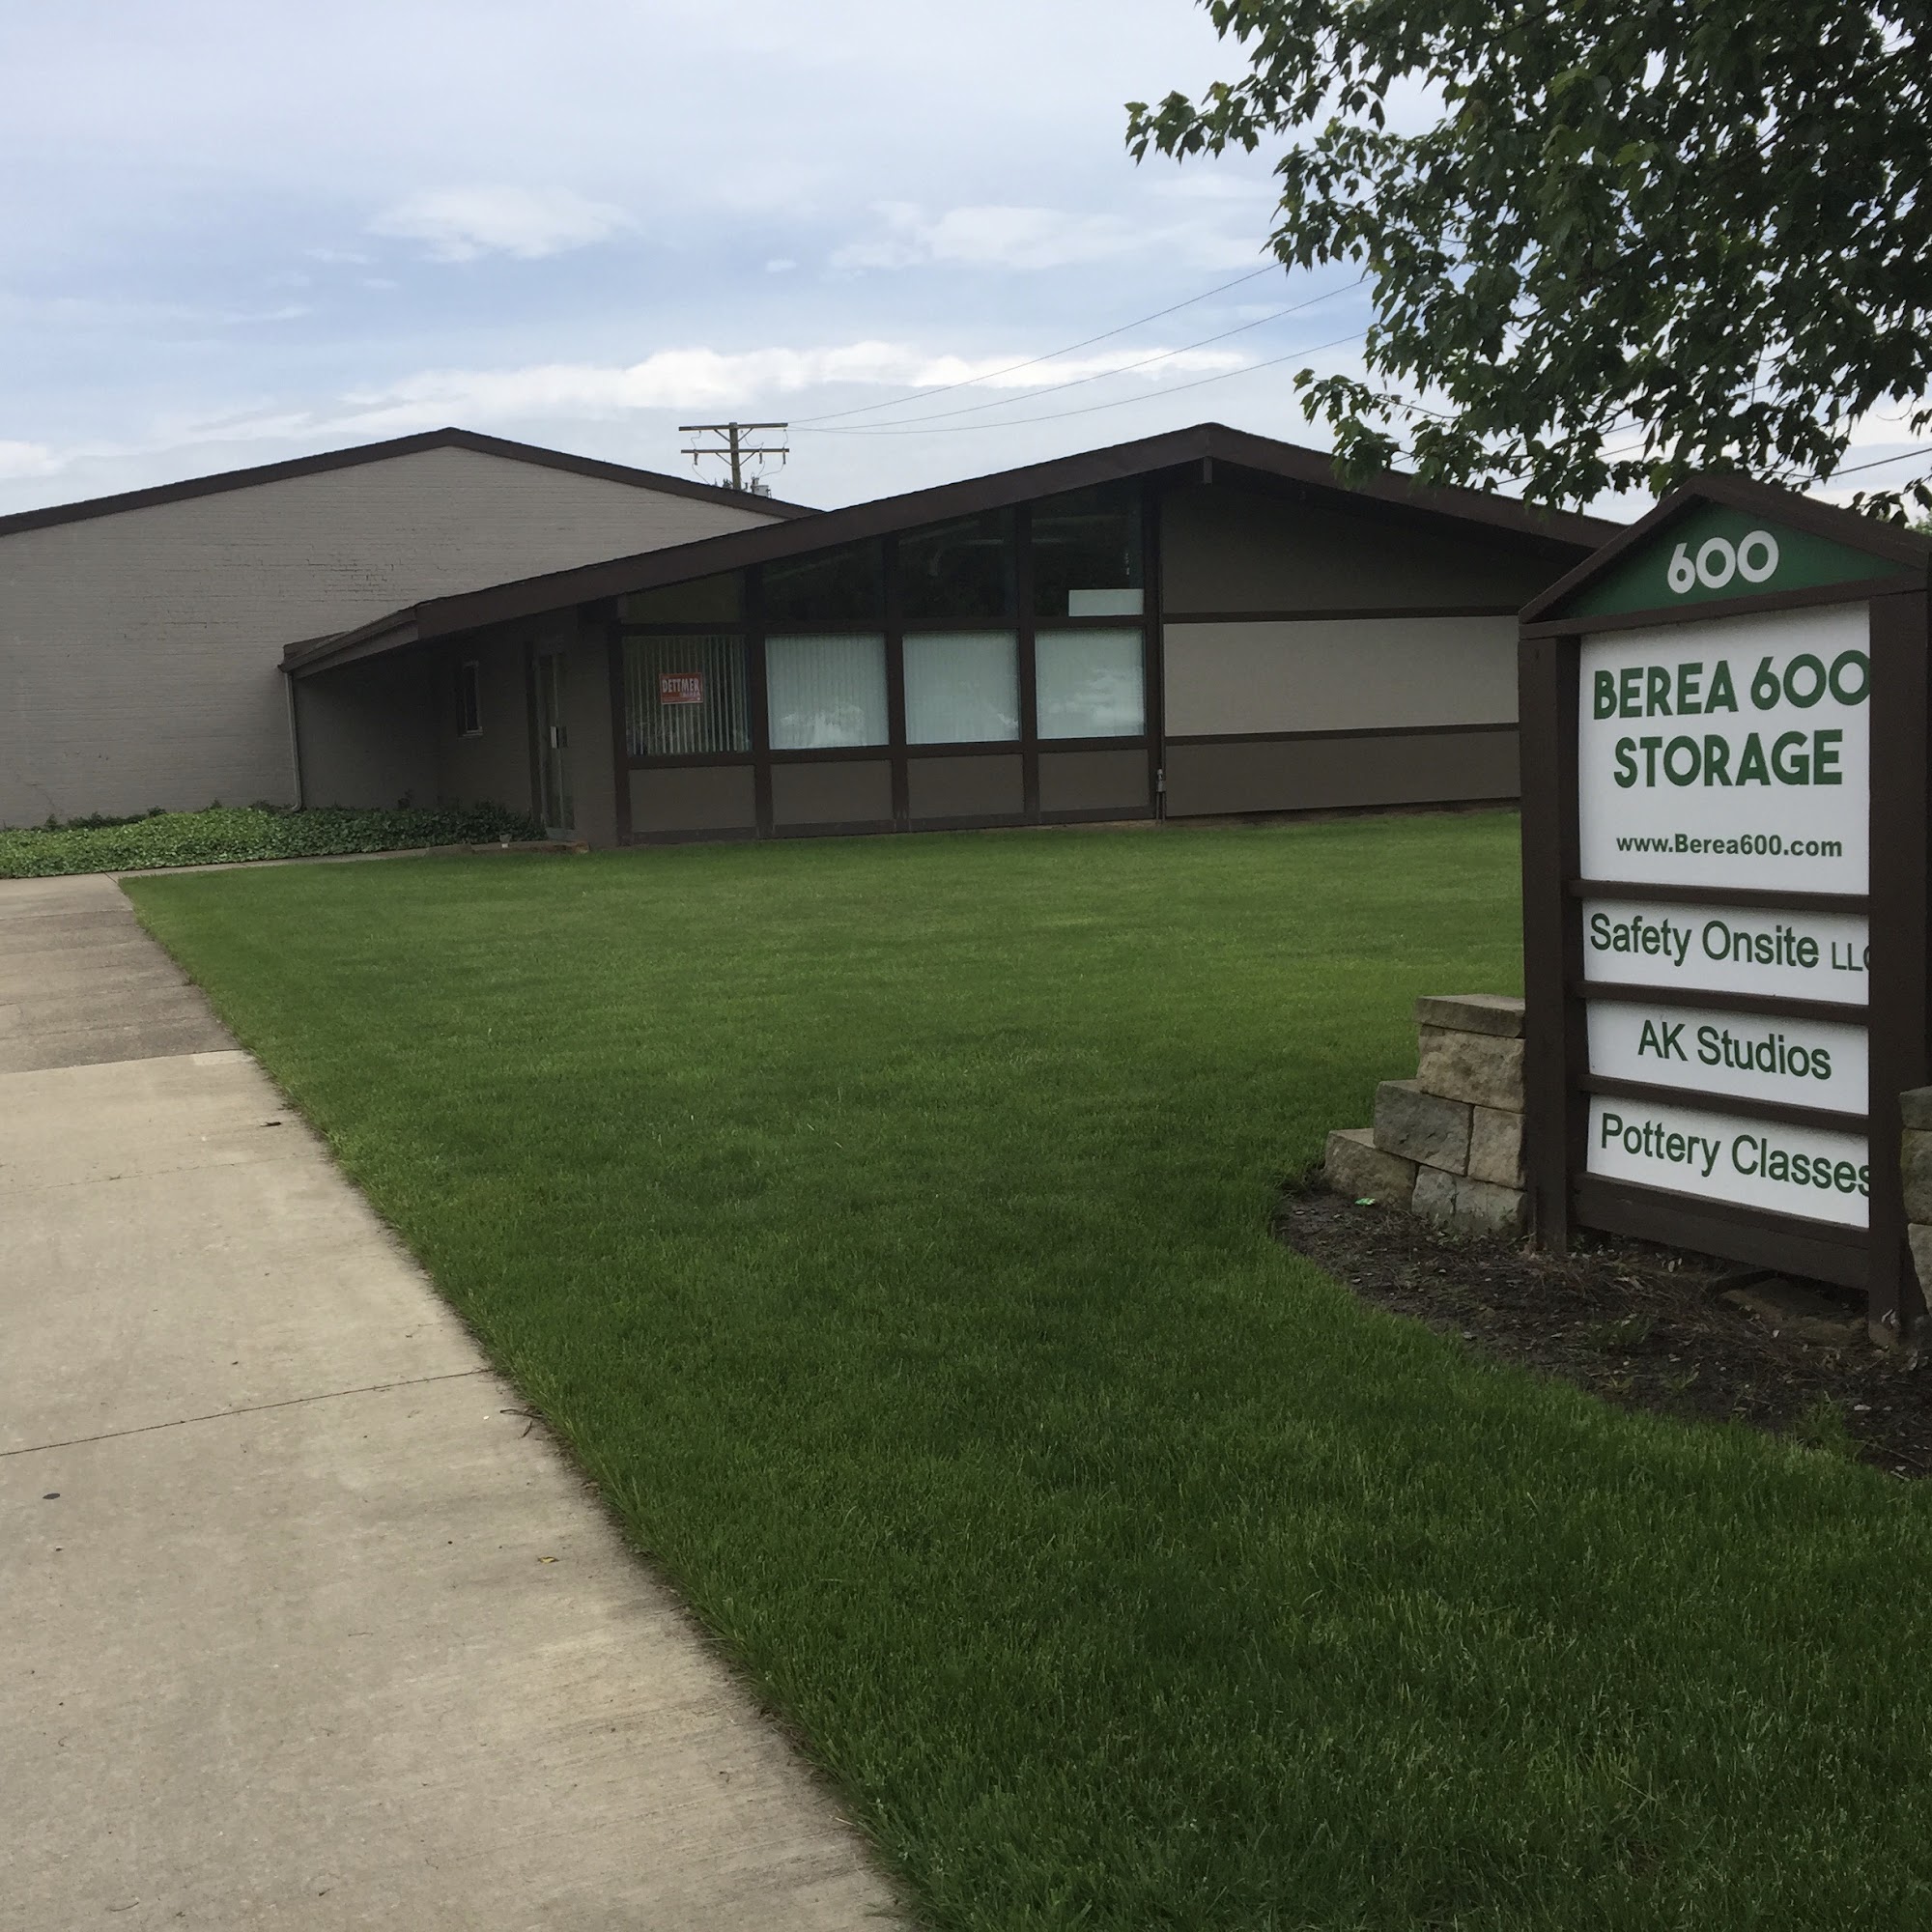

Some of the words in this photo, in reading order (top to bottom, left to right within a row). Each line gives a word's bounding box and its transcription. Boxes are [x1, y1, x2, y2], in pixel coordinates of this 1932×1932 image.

[1667, 530, 1779, 594] 600
[1594, 660, 1739, 720] BEREA
[1750, 649, 1870, 711] 600
[1613, 729, 1843, 788] STORAGE
[1616, 834, 1842, 857] www.Berea600.com
[1590, 913, 1692, 967] Safety
[1702, 921, 1819, 968] Onsite
[1832, 942, 1869, 971] LL
[1637, 1019, 1689, 1062] AK
[1696, 1026, 1832, 1080] Studios
[1601, 1112, 1721, 1178] Pottery
